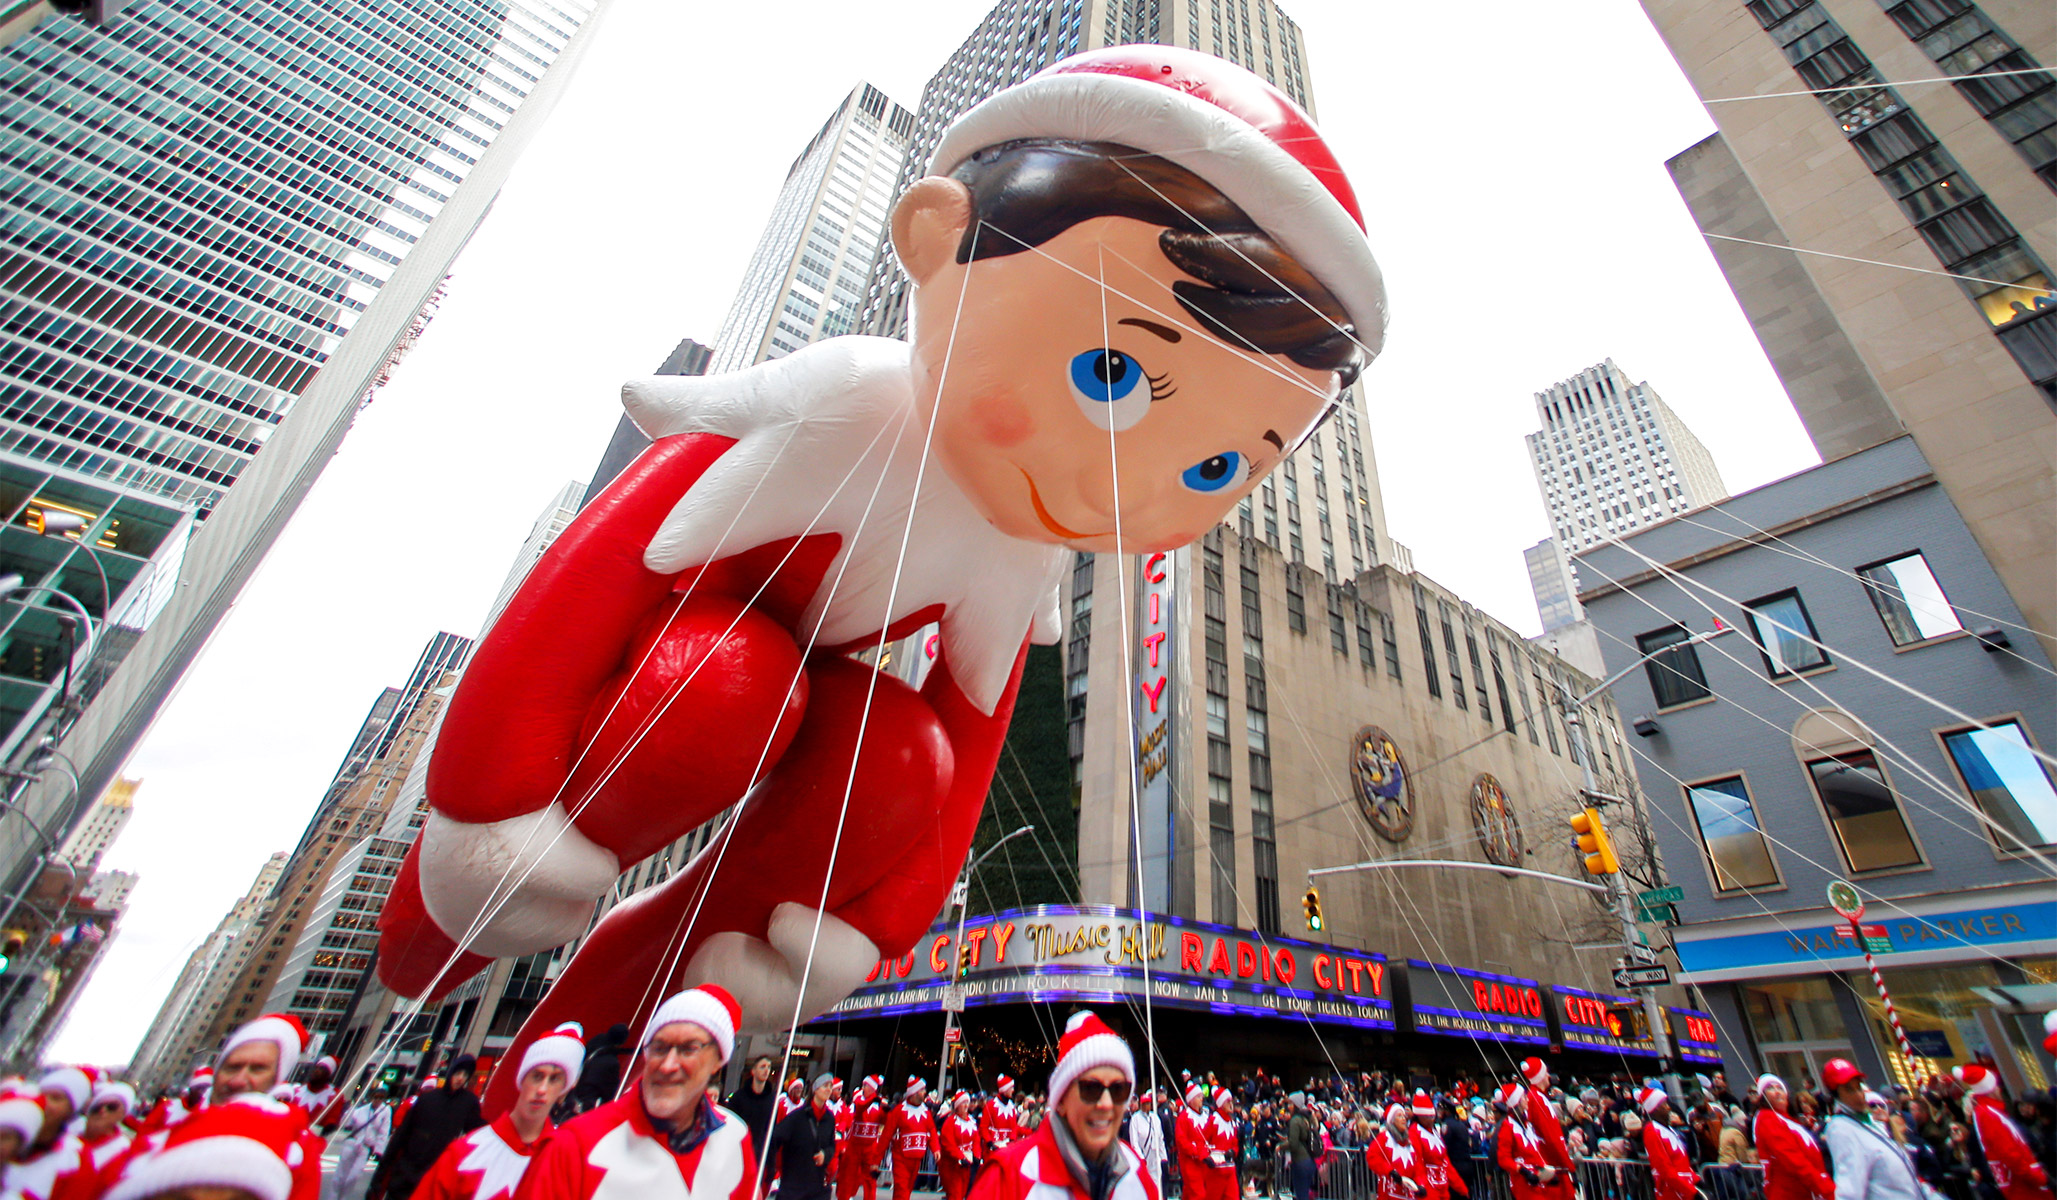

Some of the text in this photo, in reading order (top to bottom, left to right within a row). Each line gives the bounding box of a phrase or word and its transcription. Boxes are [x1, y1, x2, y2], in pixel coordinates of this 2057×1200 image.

[1142, 552, 1167, 713] CITY
[1025, 923, 1110, 961] Music
[1104, 922, 1169, 965] Hall
[1786, 931, 1862, 953] WAR
[1898, 913, 2027, 943] PARKER
[1181, 931, 1384, 995] RADIO CITY
[1618, 970, 1662, 981] ONE WAY
[888, 987, 929, 1004] STARRING
[992, 976, 1018, 993] CITY
[1027, 975, 1125, 991] ROCKETTES
[1155, 980, 1180, 998] NOW
[1194, 985, 1215, 1001] JAN
[1222, 988, 1228, 1002] 5
[1262, 993, 1388, 1020] GET YOUR TICKETS TODAY!
[1473, 980, 1541, 1017] RADIO
[1418, 1013, 1432, 1025] SEE
[1436, 1015, 1449, 1027] THE
[1499, 1022, 1514, 1034] NOW
[1520, 1025, 1533, 1037] JAN
[1565, 994, 1607, 1028] CITY
